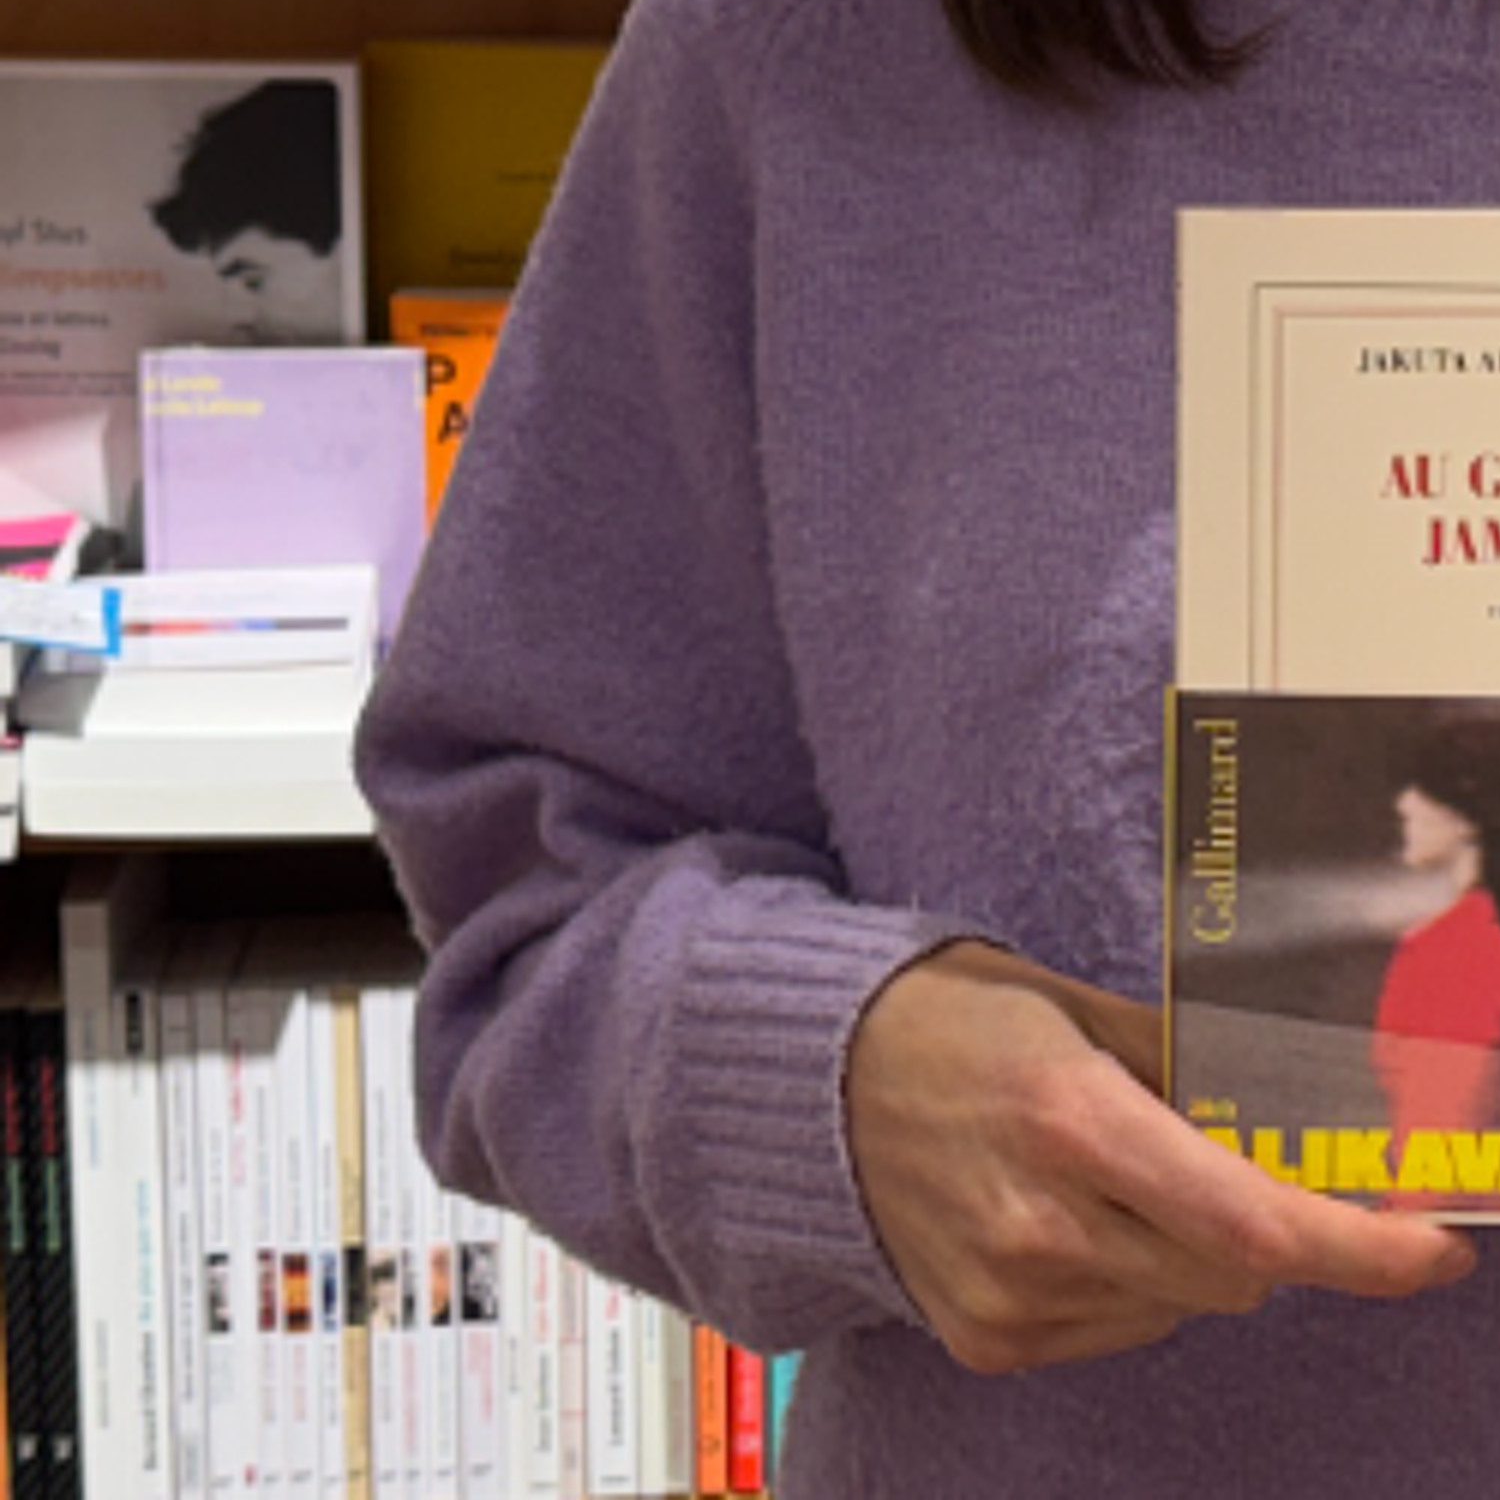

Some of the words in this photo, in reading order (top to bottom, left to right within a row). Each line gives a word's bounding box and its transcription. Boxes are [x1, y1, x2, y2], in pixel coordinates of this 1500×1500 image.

[1356, 347, 1469, 376] JAKUTA
[1381, 453, 1448, 500] AU
[1191, 718, 1239, 944] Gallimard
